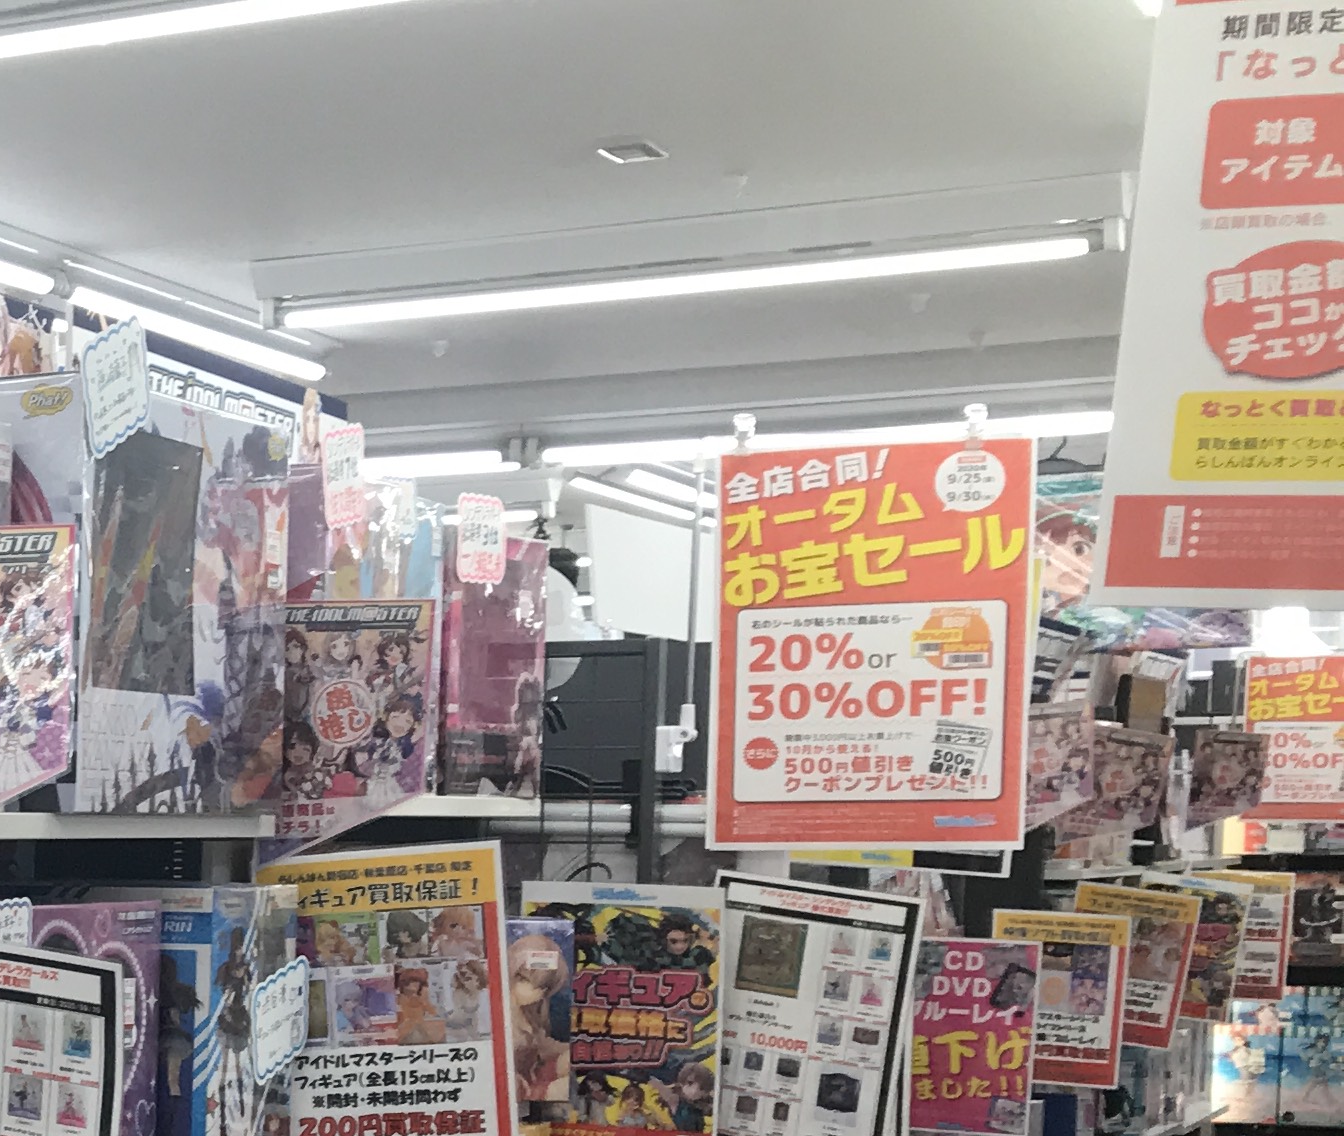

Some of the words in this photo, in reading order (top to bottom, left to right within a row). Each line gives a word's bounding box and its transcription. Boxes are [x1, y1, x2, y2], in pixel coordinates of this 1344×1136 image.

[1221, 8, 1344, 41] 期間限定
[1254, 117, 1317, 146] 対象
[1200, 399, 1344, 418] なっとく買取
[725, 448, 891, 505] 全店合同!
[725, 482, 926, 550] オータム
[724, 514, 1027, 607] お宝セール
[748, 632, 865, 673] 20%
[867, 652, 898, 669] or
[747, 678, 989, 721] 30%OFF!
[1249, 671, 1340, 697] オータム
[296, 877, 479, 908] ィギュア買取保証！
[943, 951, 985, 971] CD
[932, 976, 992, 997] DVD
[915, 1076, 1025, 1100] ました!!
